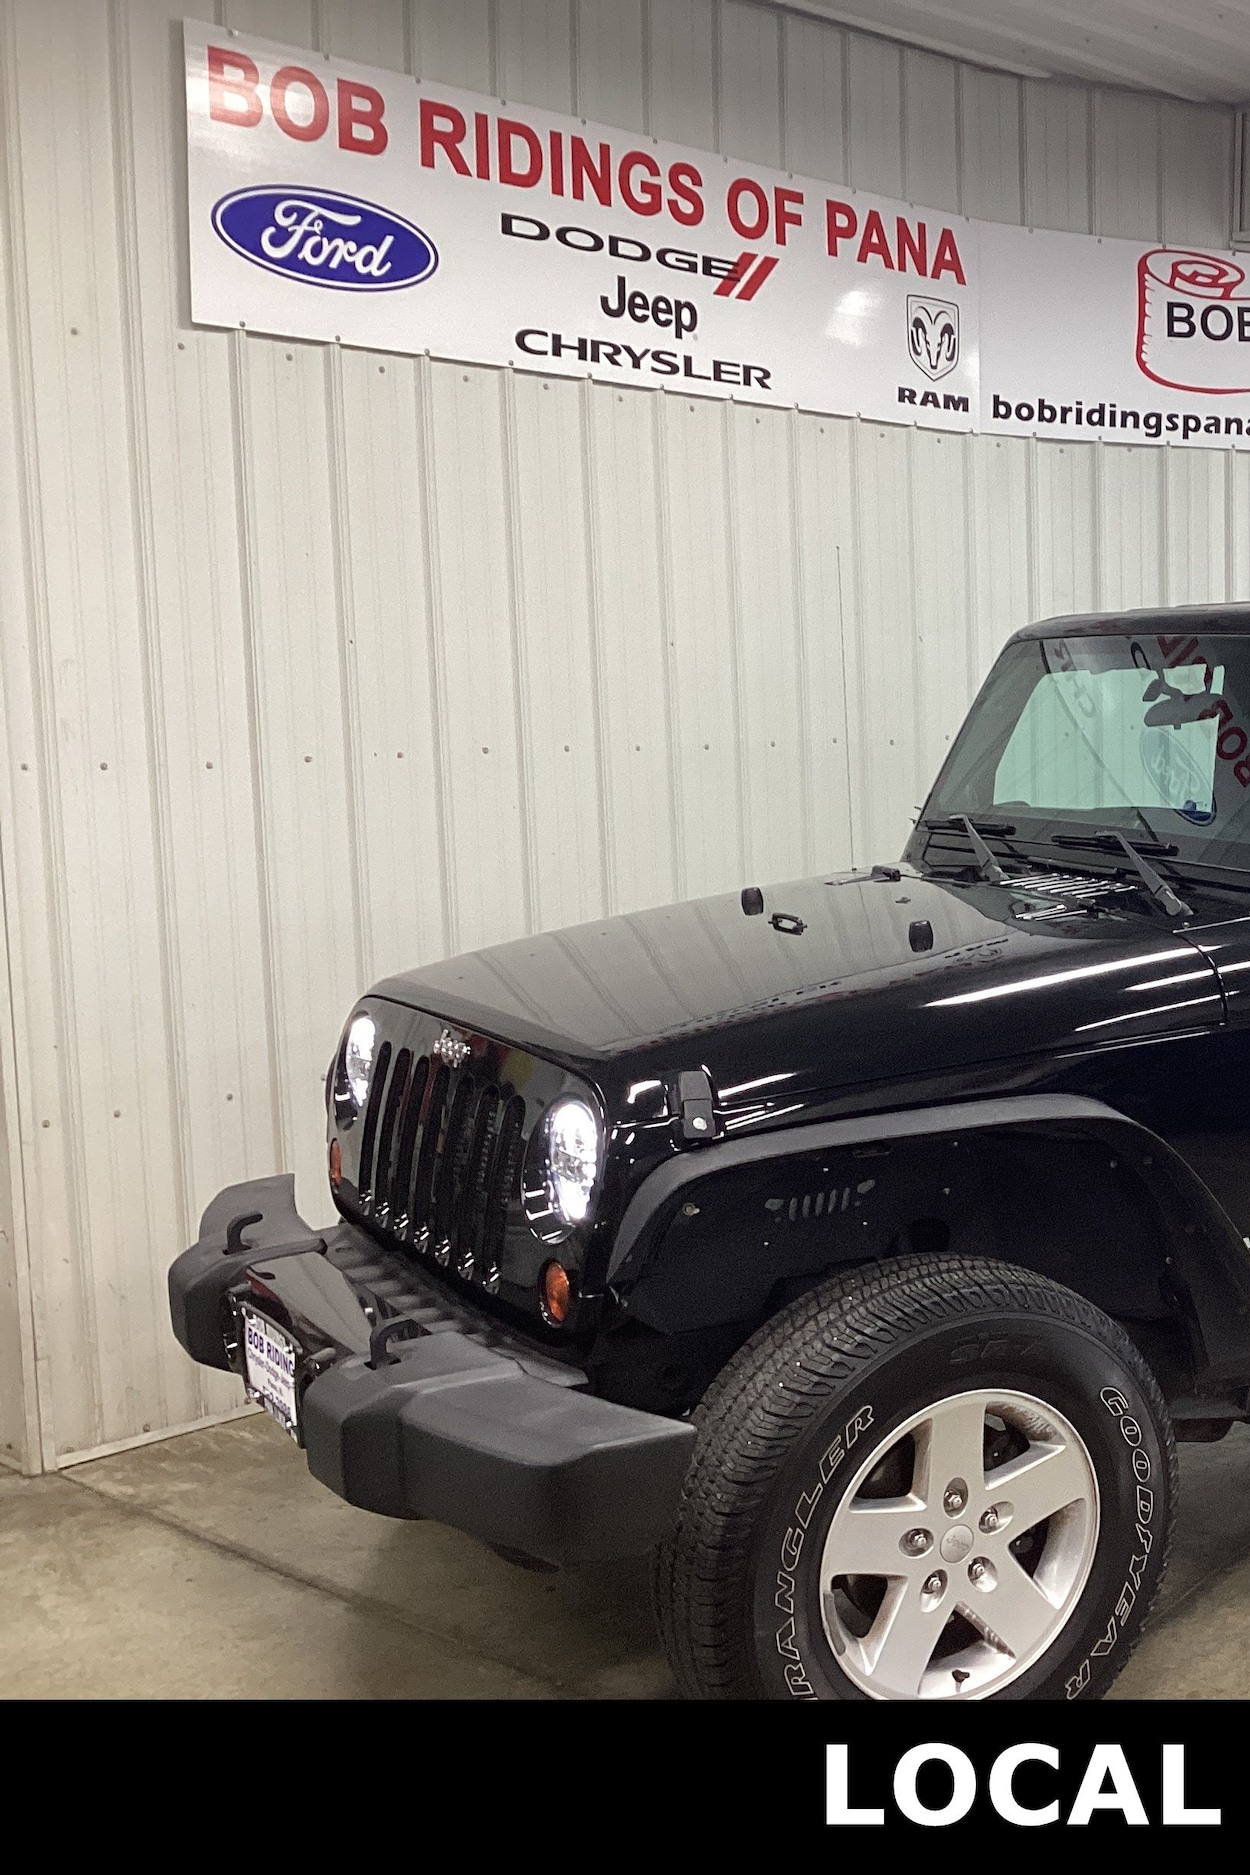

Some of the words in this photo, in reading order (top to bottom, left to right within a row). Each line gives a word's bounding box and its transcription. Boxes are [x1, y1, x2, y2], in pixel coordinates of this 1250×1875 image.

[206, 45, 389, 157] BOB
[419, 98, 706, 227] RIDINGS
[726, 177, 805, 247] OF
[825, 200, 968, 288] PANA
[260, 199, 395, 280] Ford
[500, 212, 741, 284] DODGE
[600, 275, 700, 340] Jeep
[514, 328, 774, 392] CHRYSLER
[897, 387, 970, 414] RAM
[247, 1326, 265, 1354] BOB
[774, 1404, 875, 1700] RANGLER
[1066, 1386, 1154, 1700] GOODYEAR
